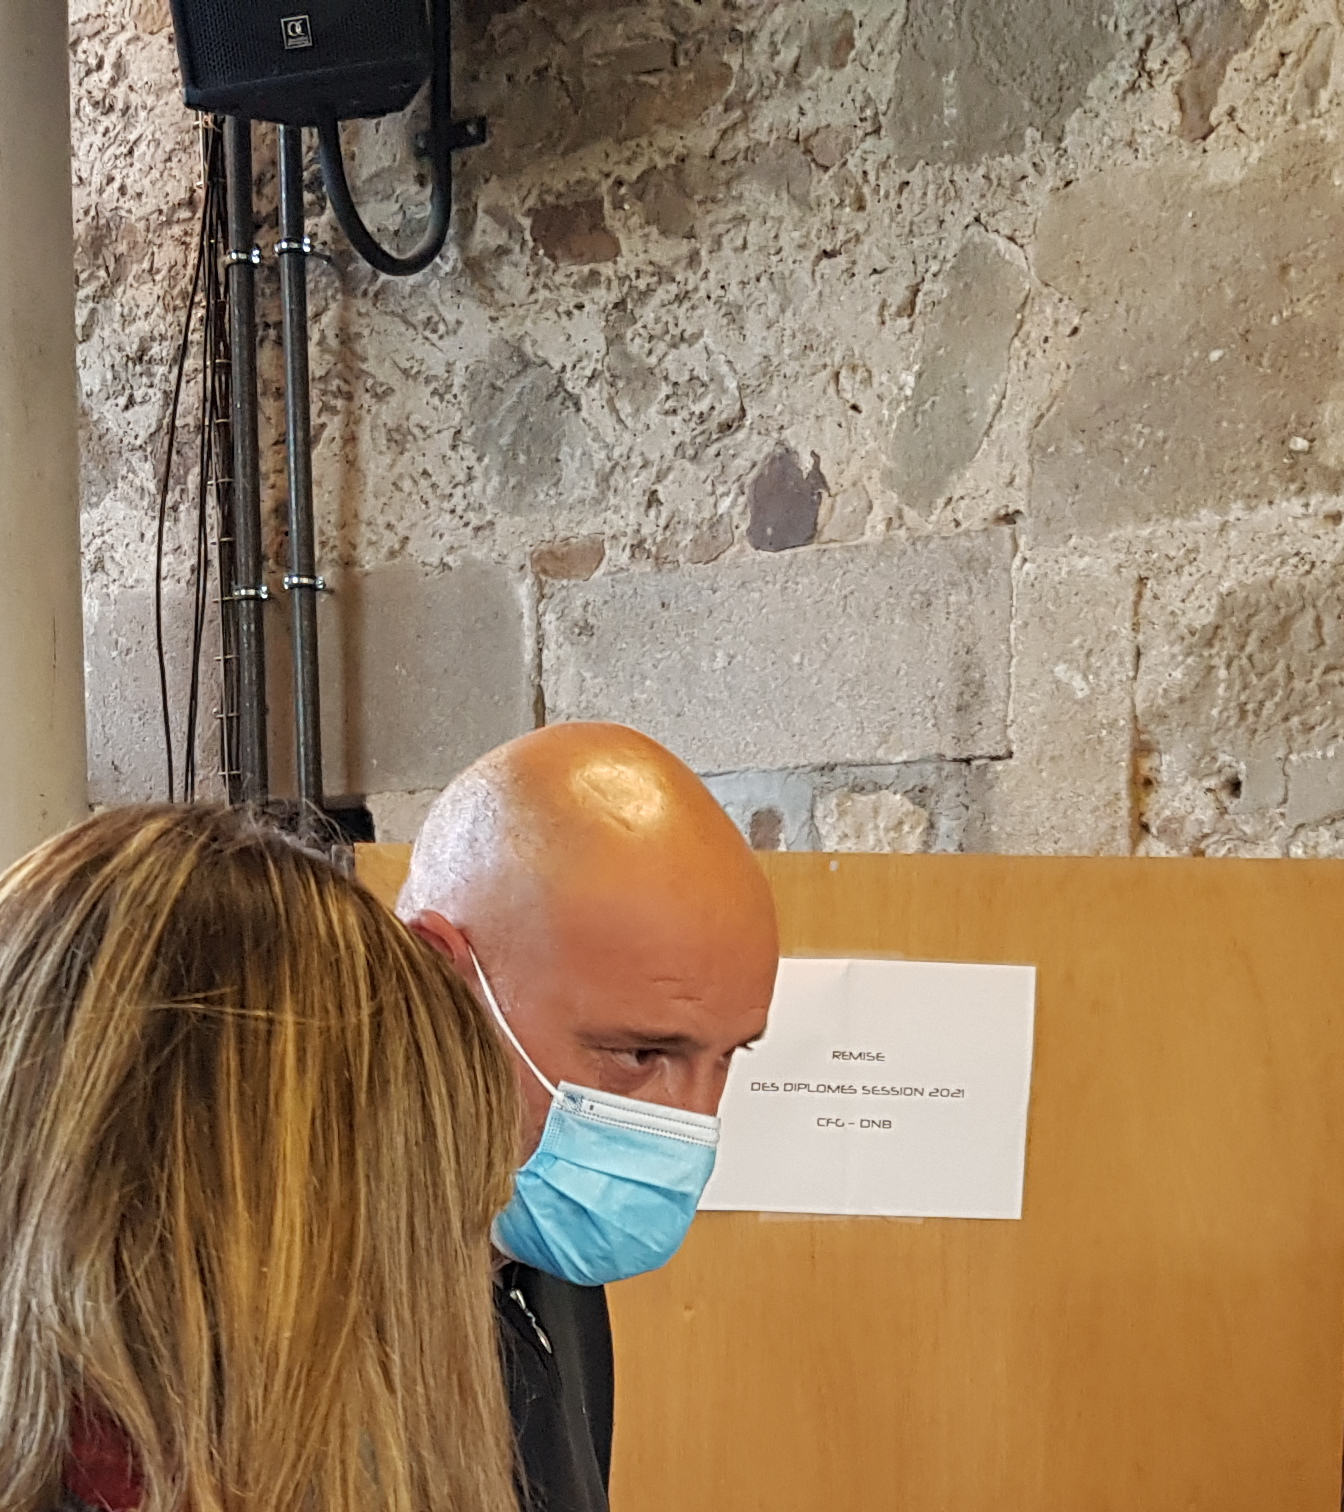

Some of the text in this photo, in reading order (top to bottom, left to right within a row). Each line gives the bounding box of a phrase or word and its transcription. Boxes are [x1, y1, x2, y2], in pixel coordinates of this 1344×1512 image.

[831, 1050, 886, 1062] REMISE
[750, 1081, 965, 1099] DES DIPLOMES SESSION 2021
[816, 1117, 846, 1128] CFG
[859, 1118, 893, 1130] DNB
